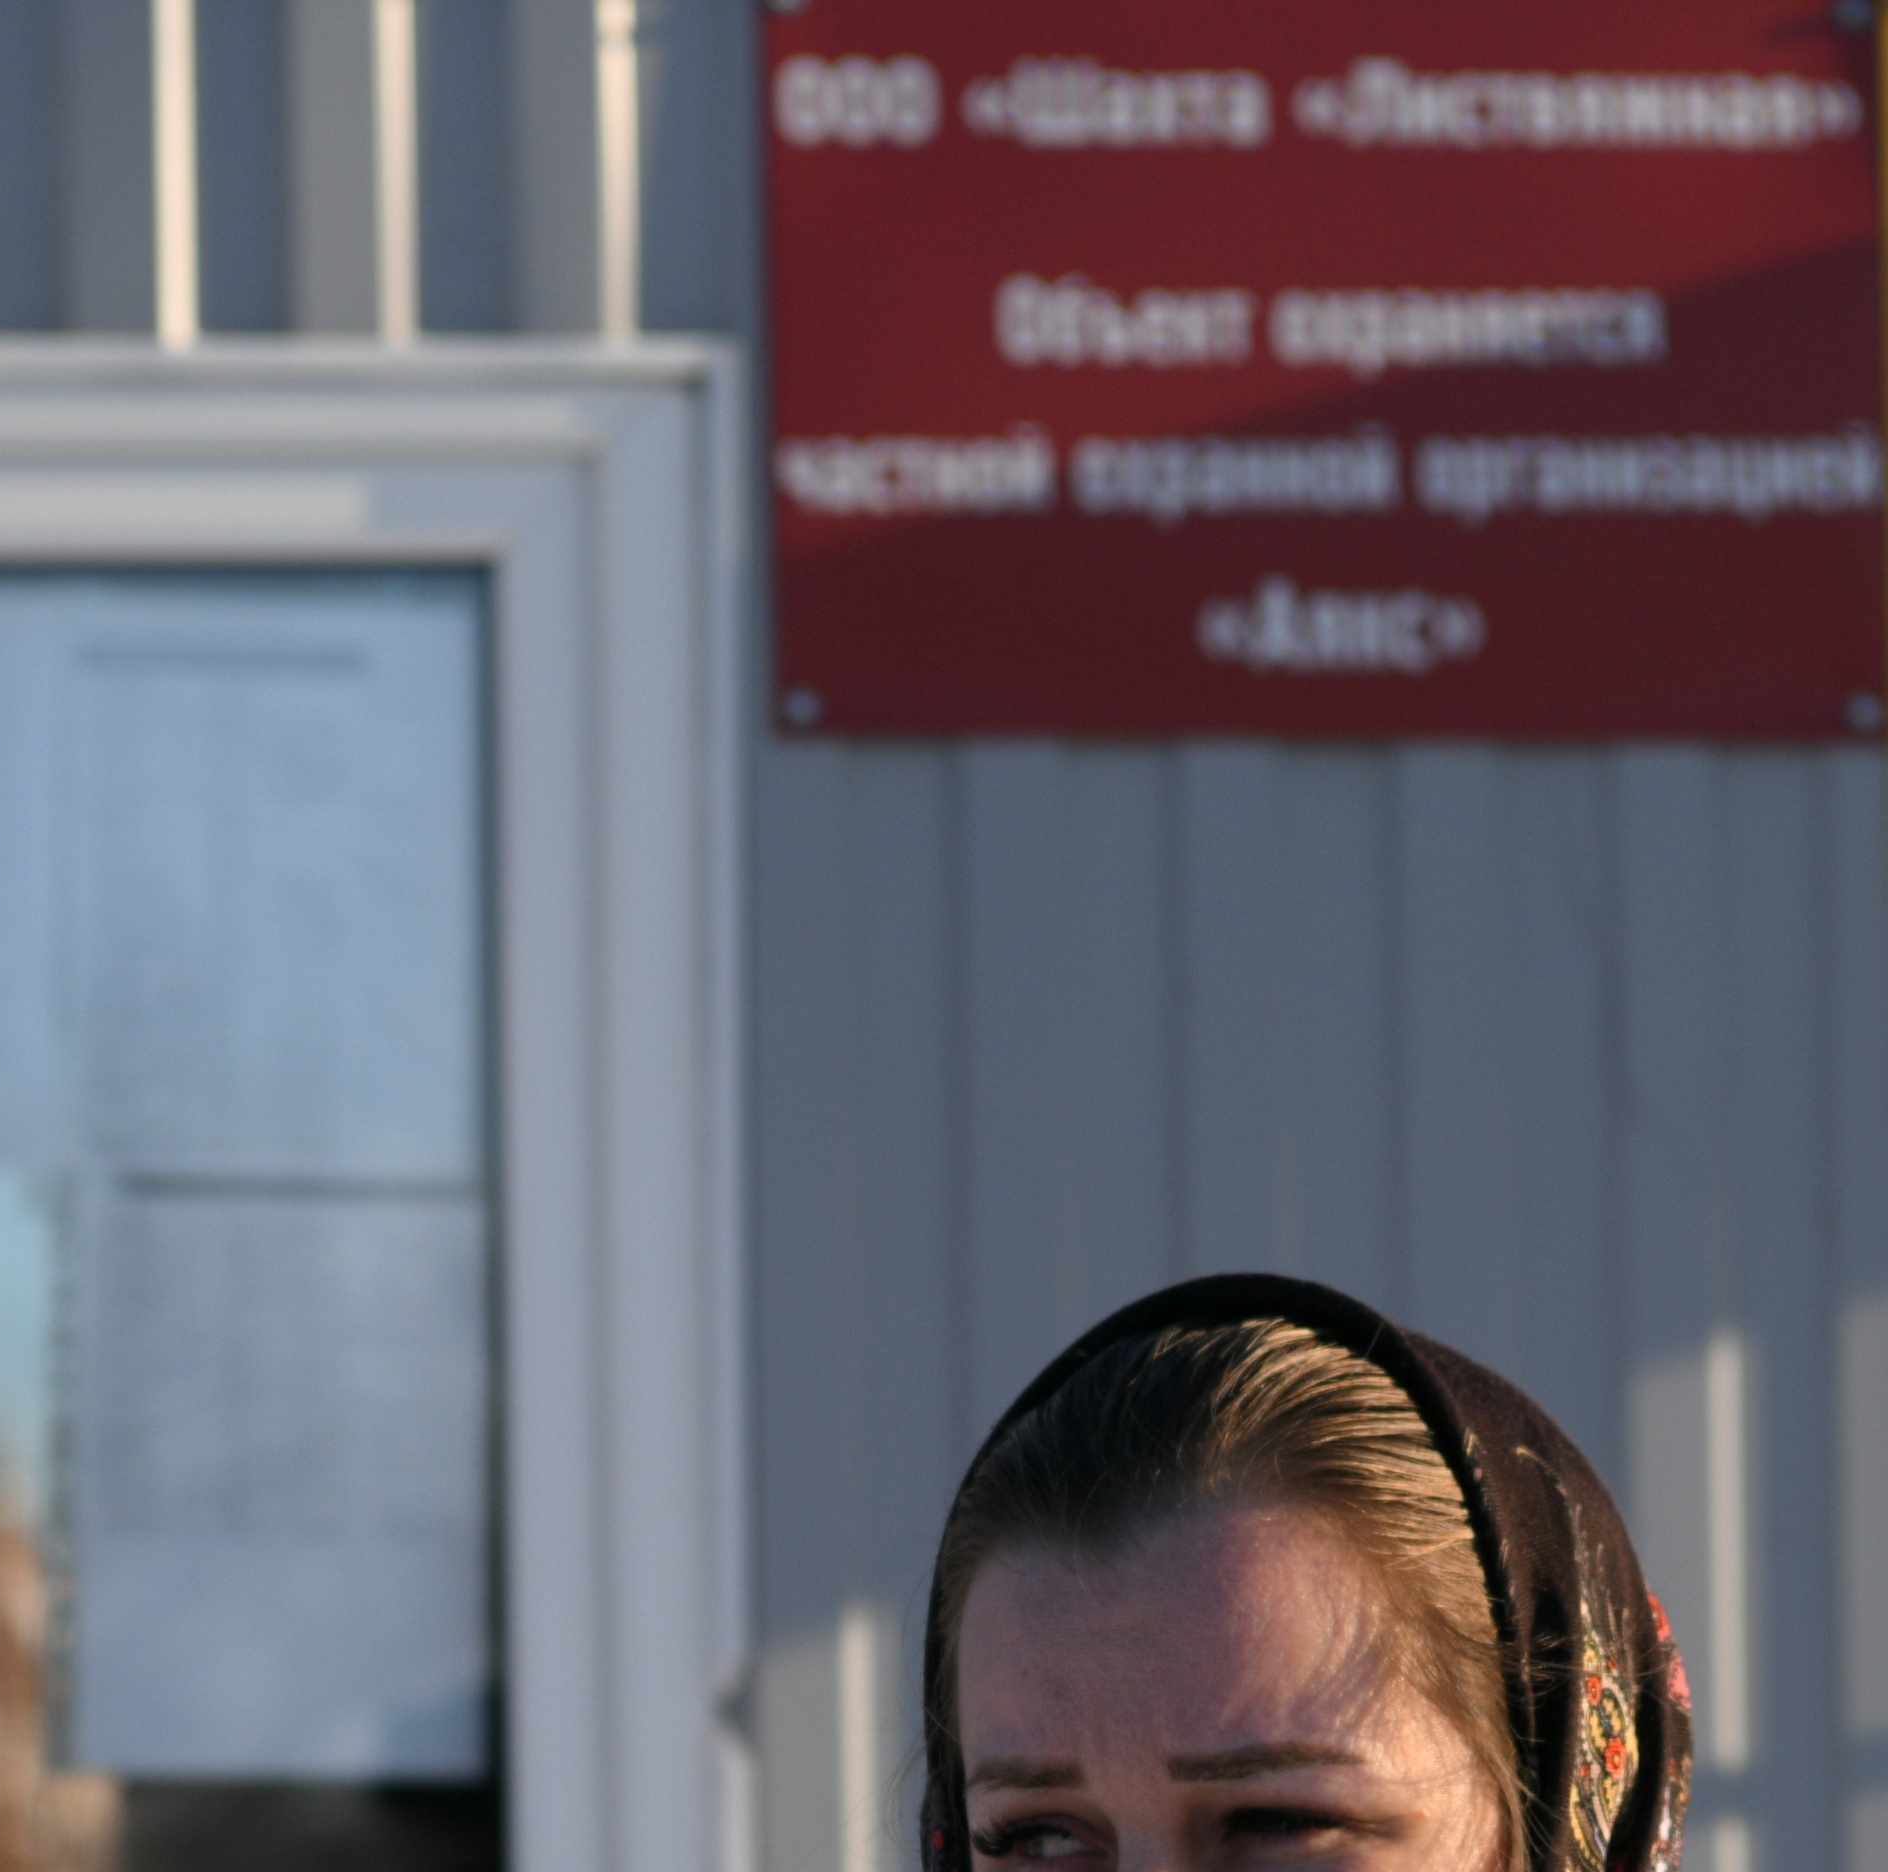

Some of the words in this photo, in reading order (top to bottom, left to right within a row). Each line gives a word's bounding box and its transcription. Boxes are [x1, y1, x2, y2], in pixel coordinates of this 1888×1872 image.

[776, 57, 938, 144] ООО
[964, 57, 1271, 146] «Шахта
[1297, 59, 1857, 147] «Листвяжная»
[997, 277, 1251, 364] Объект
[1270, 290, 1663, 377] охраняется
[776, 428, 1054, 514] частной
[1070, 428, 1401, 524] охранной
[1415, 428, 1882, 522] организацией
